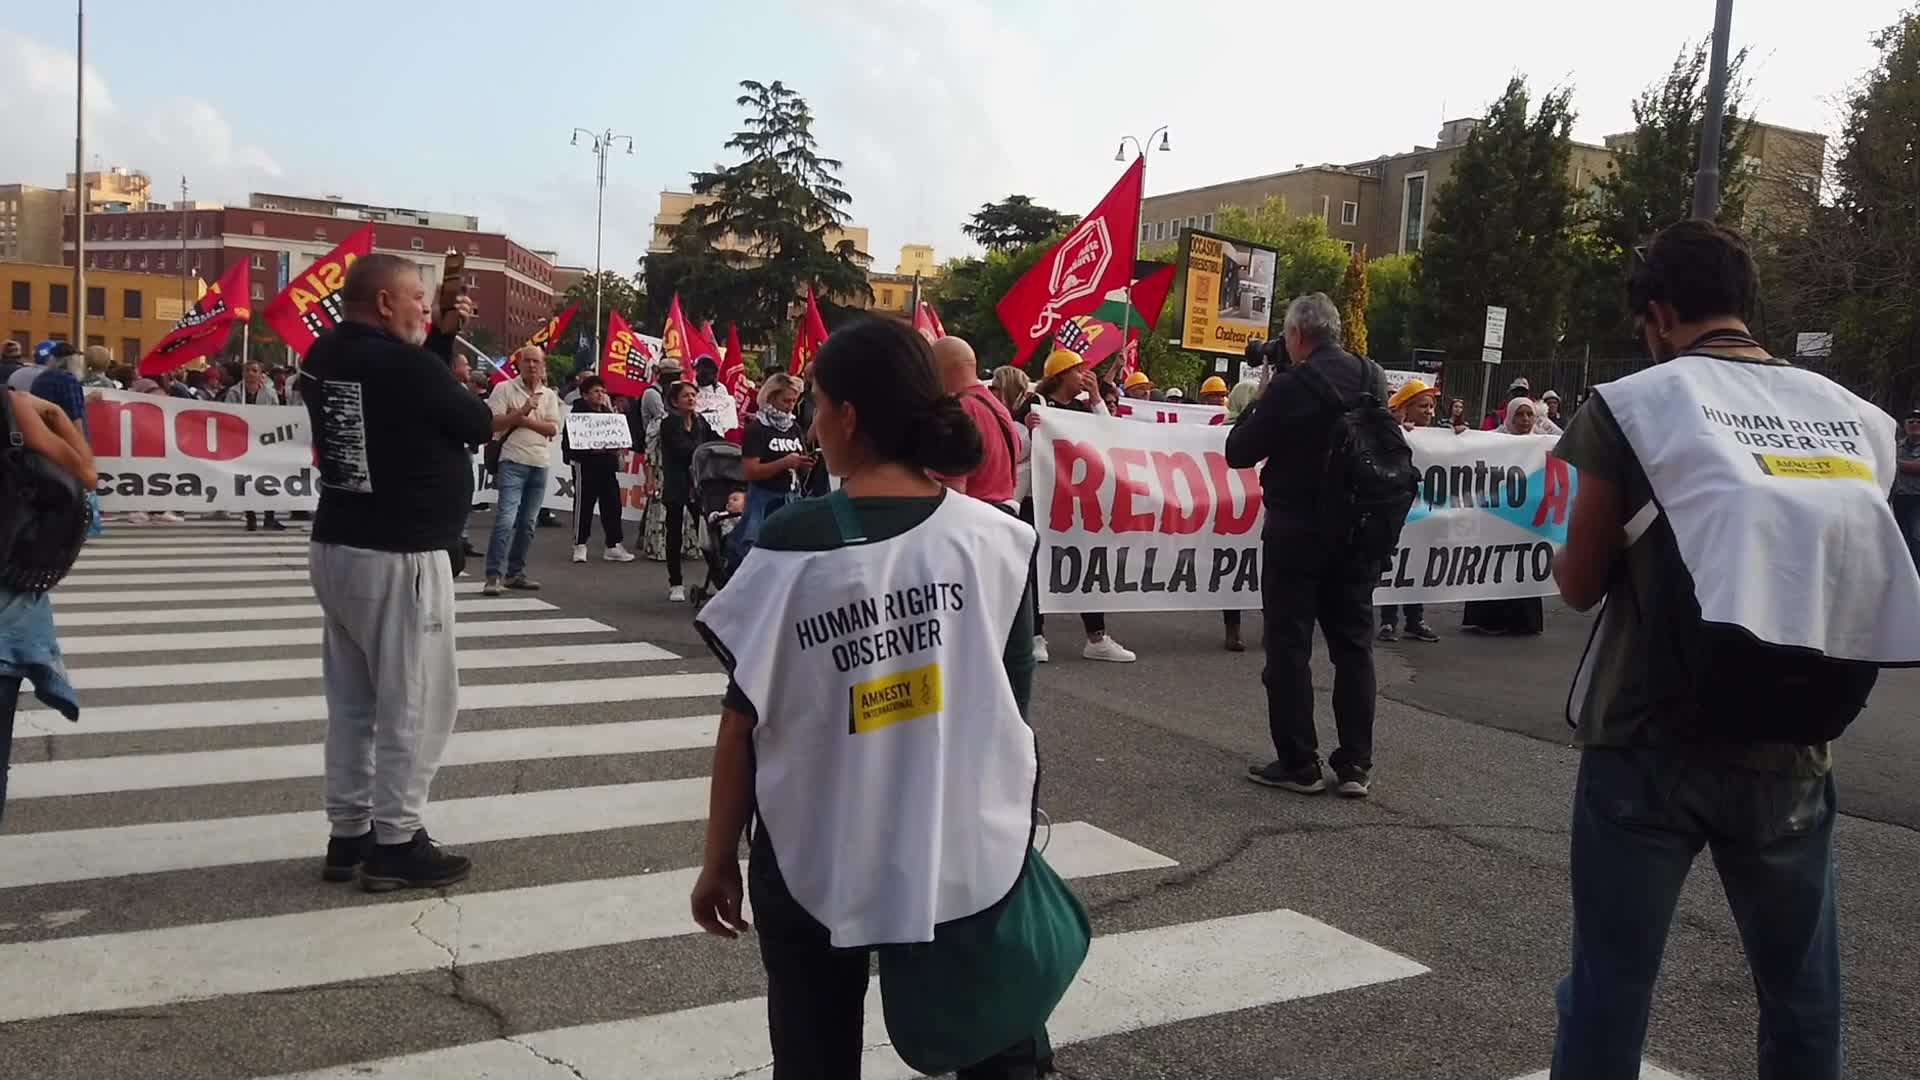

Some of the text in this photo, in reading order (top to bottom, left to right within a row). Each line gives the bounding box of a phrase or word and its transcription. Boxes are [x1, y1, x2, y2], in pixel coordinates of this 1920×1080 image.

[86, 400, 299, 461] no all'
[1701, 404, 1863, 438] HUMAN RIGHT
[1734, 430, 1861, 456] OBSERVER
[1776, 459, 1832, 469] AMNESTY
[96, 472, 218, 503] casa,
[1413, 460, 1527, 508] ontro
[1049, 546, 1197, 594] DALLA
[1422, 541, 1554, 588] DIRITTO
[796, 583, 964, 650] HUMAN RIGHTS
[831, 618, 942, 672] OBSERVER
[861, 681, 912, 709] AMNESTY
[862, 699, 914, 720] INTERNATIONAL
